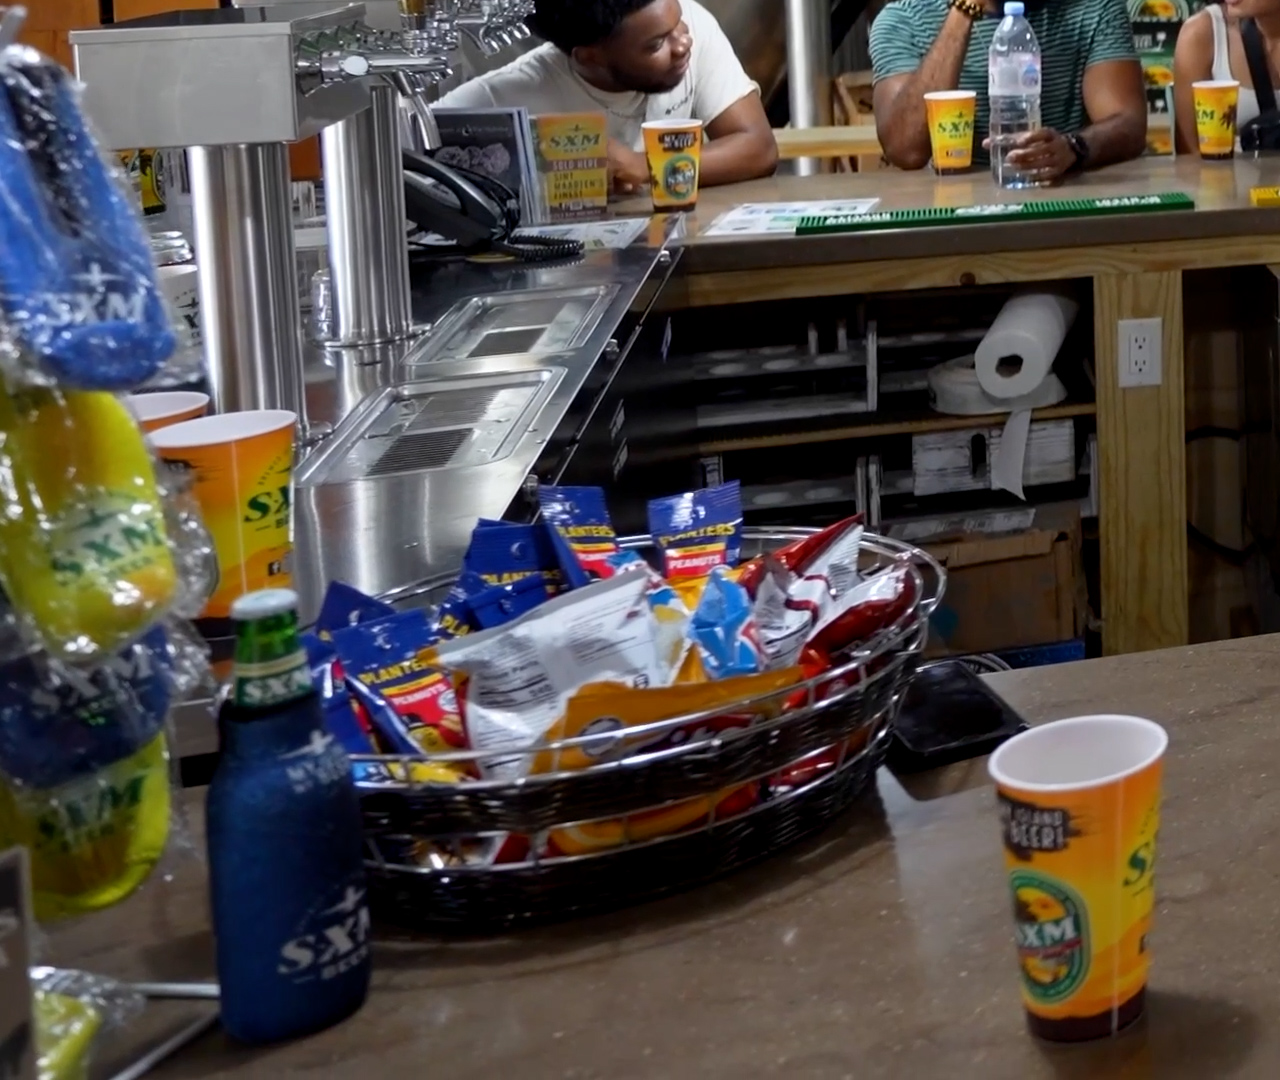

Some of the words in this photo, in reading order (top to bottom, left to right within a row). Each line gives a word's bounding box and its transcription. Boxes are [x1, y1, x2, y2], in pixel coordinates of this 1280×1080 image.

[550, 133, 601, 149] SXM
[553, 160, 575, 171] SOLD
[577, 159, 598, 170] HERE
[668, 554, 722, 570] PEANUTS
[359, 658, 427, 686] PLANTE
[1014, 808, 1064, 826] ISLAND
[1010, 824, 1065, 850] BEER!
